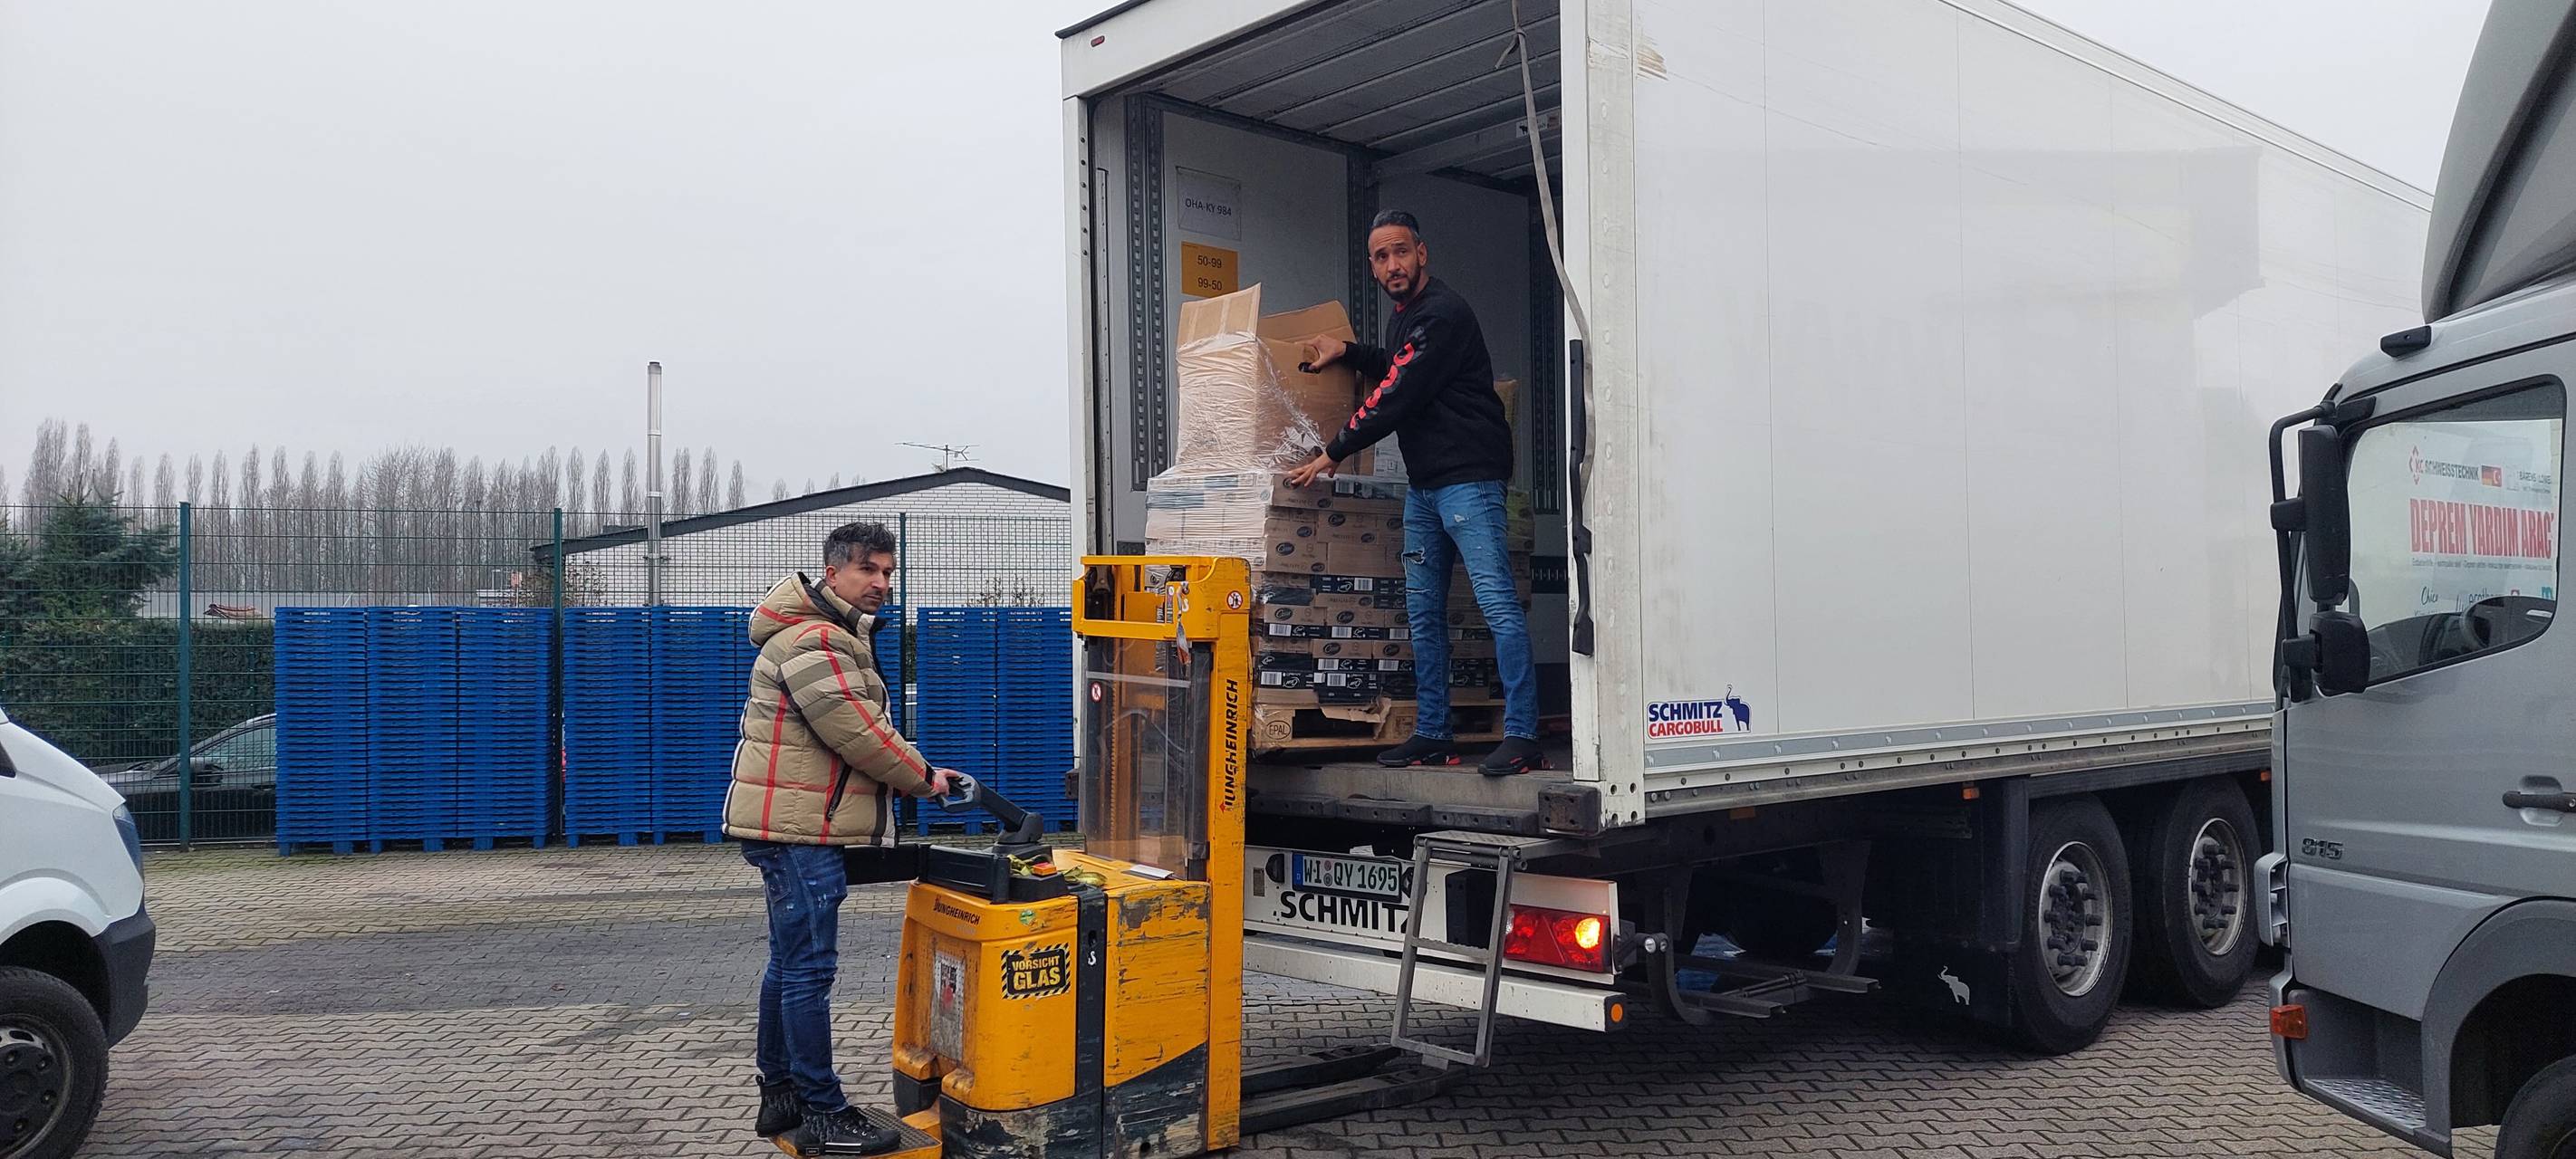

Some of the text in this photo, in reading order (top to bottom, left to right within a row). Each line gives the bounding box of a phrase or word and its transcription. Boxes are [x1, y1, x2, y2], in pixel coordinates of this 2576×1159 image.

[1185, 197, 1232, 216] OHA-KY 984
[1197, 254, 1222, 269] 50-99
[1197, 277, 1223, 291] 99-50
[2410, 498, 2554, 559] DEPREM YARDIM ARAC
[1648, 701, 1723, 722] SCHMITZ
[1269, 725, 1287, 736] EPAL
[1648, 720, 1723, 736] CARGOBULL
[2302, 838, 2343, 860] 815
[1333, 862, 1354, 888] QY
[1357, 866, 1398, 892] 1695
[1011, 955, 1061, 972] VORSICHT
[1013, 966, 1062, 991] GLAS
